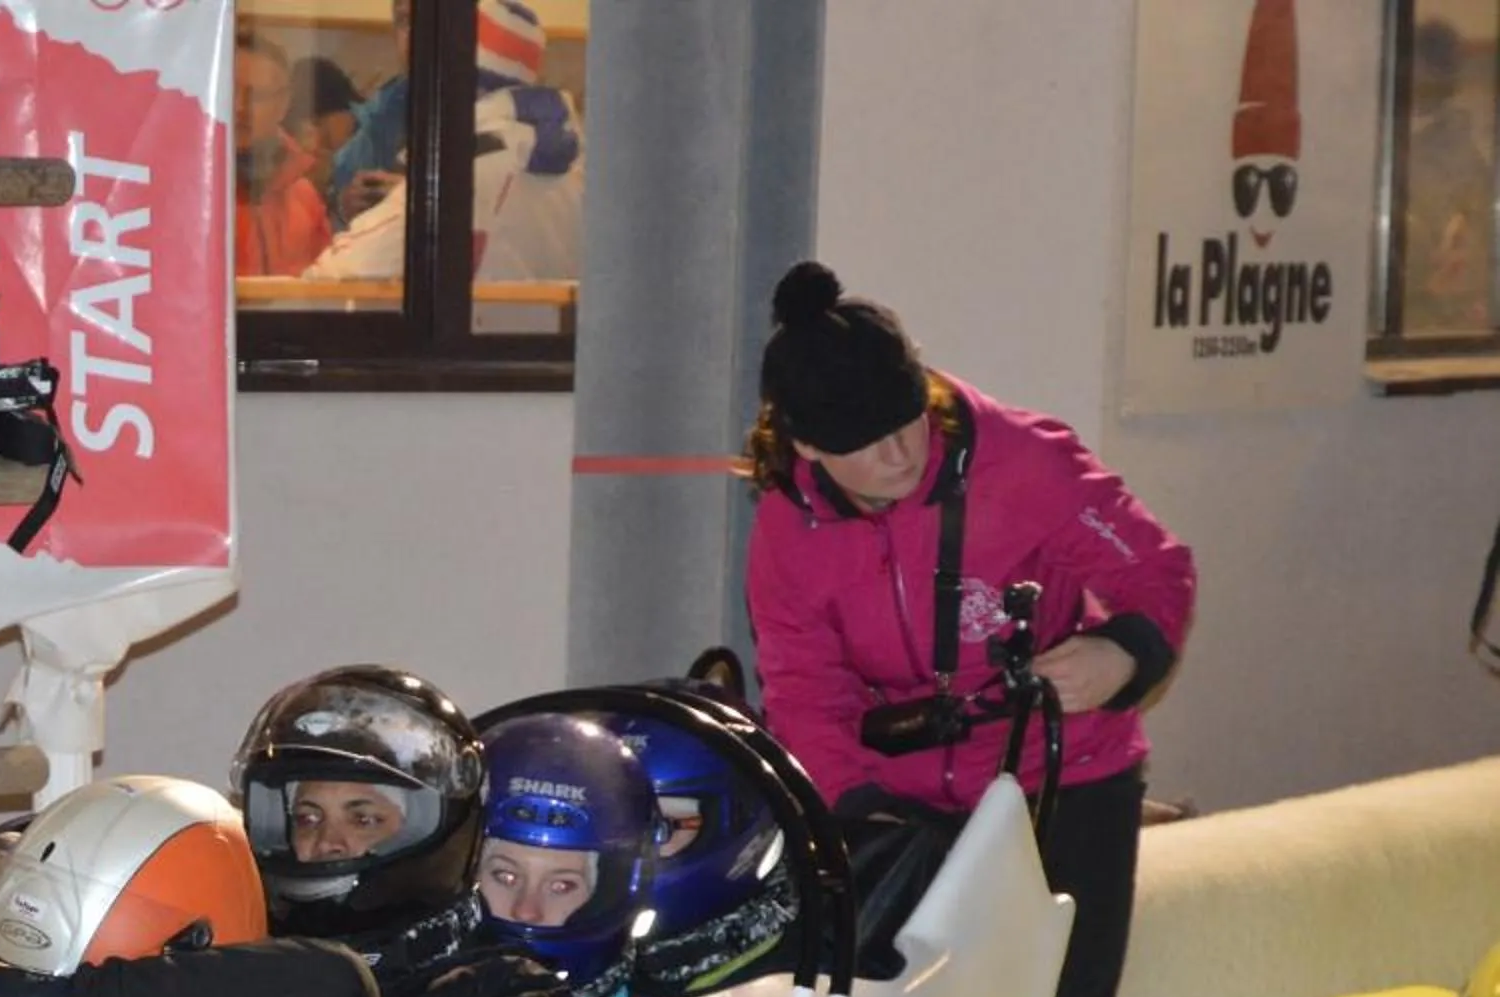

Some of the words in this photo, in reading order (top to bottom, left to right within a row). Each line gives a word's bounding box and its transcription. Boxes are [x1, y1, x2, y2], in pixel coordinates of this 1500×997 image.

[69, 130, 155, 459] START
[1154, 231, 1192, 329] la
[1199, 231, 1333, 353] Plagne
[509, 776, 588, 801] SHARK
